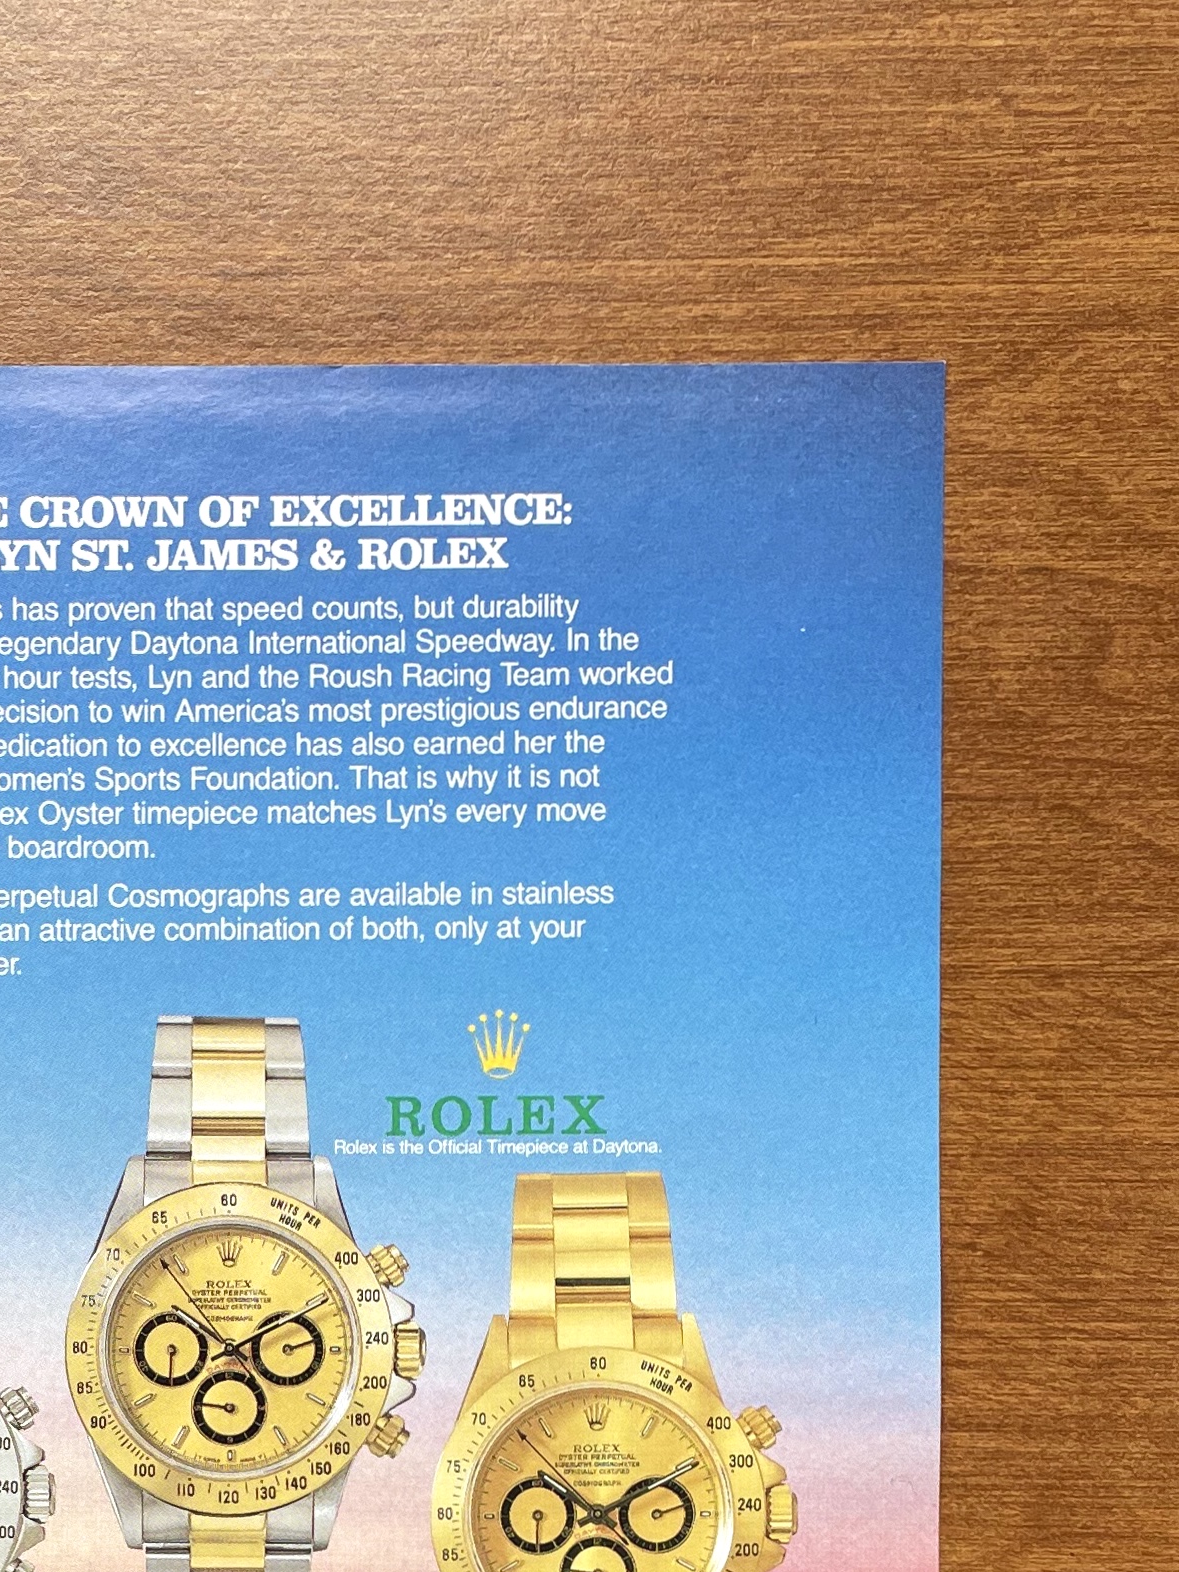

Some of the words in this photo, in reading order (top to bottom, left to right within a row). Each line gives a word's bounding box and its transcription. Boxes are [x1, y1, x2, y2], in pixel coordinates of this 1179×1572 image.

[19, 495, 189, 529] CROWN
[198, 495, 260, 529] OF
[269, 492, 573, 528] EXCELLENCE:
[71, 538, 134, 573] ST.
[146, 538, 299, 572] JAMES
[309, 537, 347, 571] &
[357, 536, 510, 571] ROLEX
[12, 596, 60, 622] has
[68, 601, 156, 628] proven
[164, 595, 214, 621] that
[221, 595, 303, 627] speed
[311, 596, 404, 624] counts,
[414, 594, 455, 620] but
[462, 592, 580, 625] durability
[130, 629, 239, 662] Daytona
[248, 628, 406, 655] International
[415, 627, 556, 660] Speedway.
[567, 626, 590, 652] In
[597, 626, 640, 652] the
[3, 664, 63, 690] hour
[69, 665, 138, 693] tests,
[148, 663, 192, 696] Lyn
[201, 663, 250, 689] and
[257, 663, 300, 689] the
[309, 662, 393, 689] Roush
[402, 662, 492, 694] Racing
[499, 661, 570, 687] Team
[578, 659, 674, 686] worked
[87, 699, 113, 724] to
[120, 698, 166, 723] win
[174, 697, 300, 723] America's
[308, 698, 373, 723] most
[380, 696, 521, 729] prestigious
[528, 695, 668, 721] endurance
[107, 882, 290, 914] Cosmographs
[298, 887, 341, 907] are
[349, 881, 462, 907] available
[471, 881, 493, 906] in
[502, 879, 615, 906] stainless
[384, 1094, 609, 1137] ROLEX
[334, 1138, 378, 1155] Rolex
[382, 1138, 396, 1155] is
[398, 1139, 424, 1155] the
[428, 1138, 482, 1155] Official
[486, 1138, 569, 1158] Timepiece
[572, 1139, 589, 1154] at
[592, 1138, 663, 1158] Daytona.
[270, 1197, 300, 1216] UNITS
[303, 1211, 321, 1229] PER
[279, 1214, 303, 1231] HOUR
[334, 1251, 359, 1266] 400
[205, 1279, 253, 1289] ROLEX
[356, 1288, 381, 1303] 300
[641, 1360, 671, 1379] UNITS
[675, 1375, 693, 1392] PER
[706, 1416, 731, 1430] 400
[573, 1443, 621, 1453] ROLEX
[728, 1454, 754, 1468] 300
